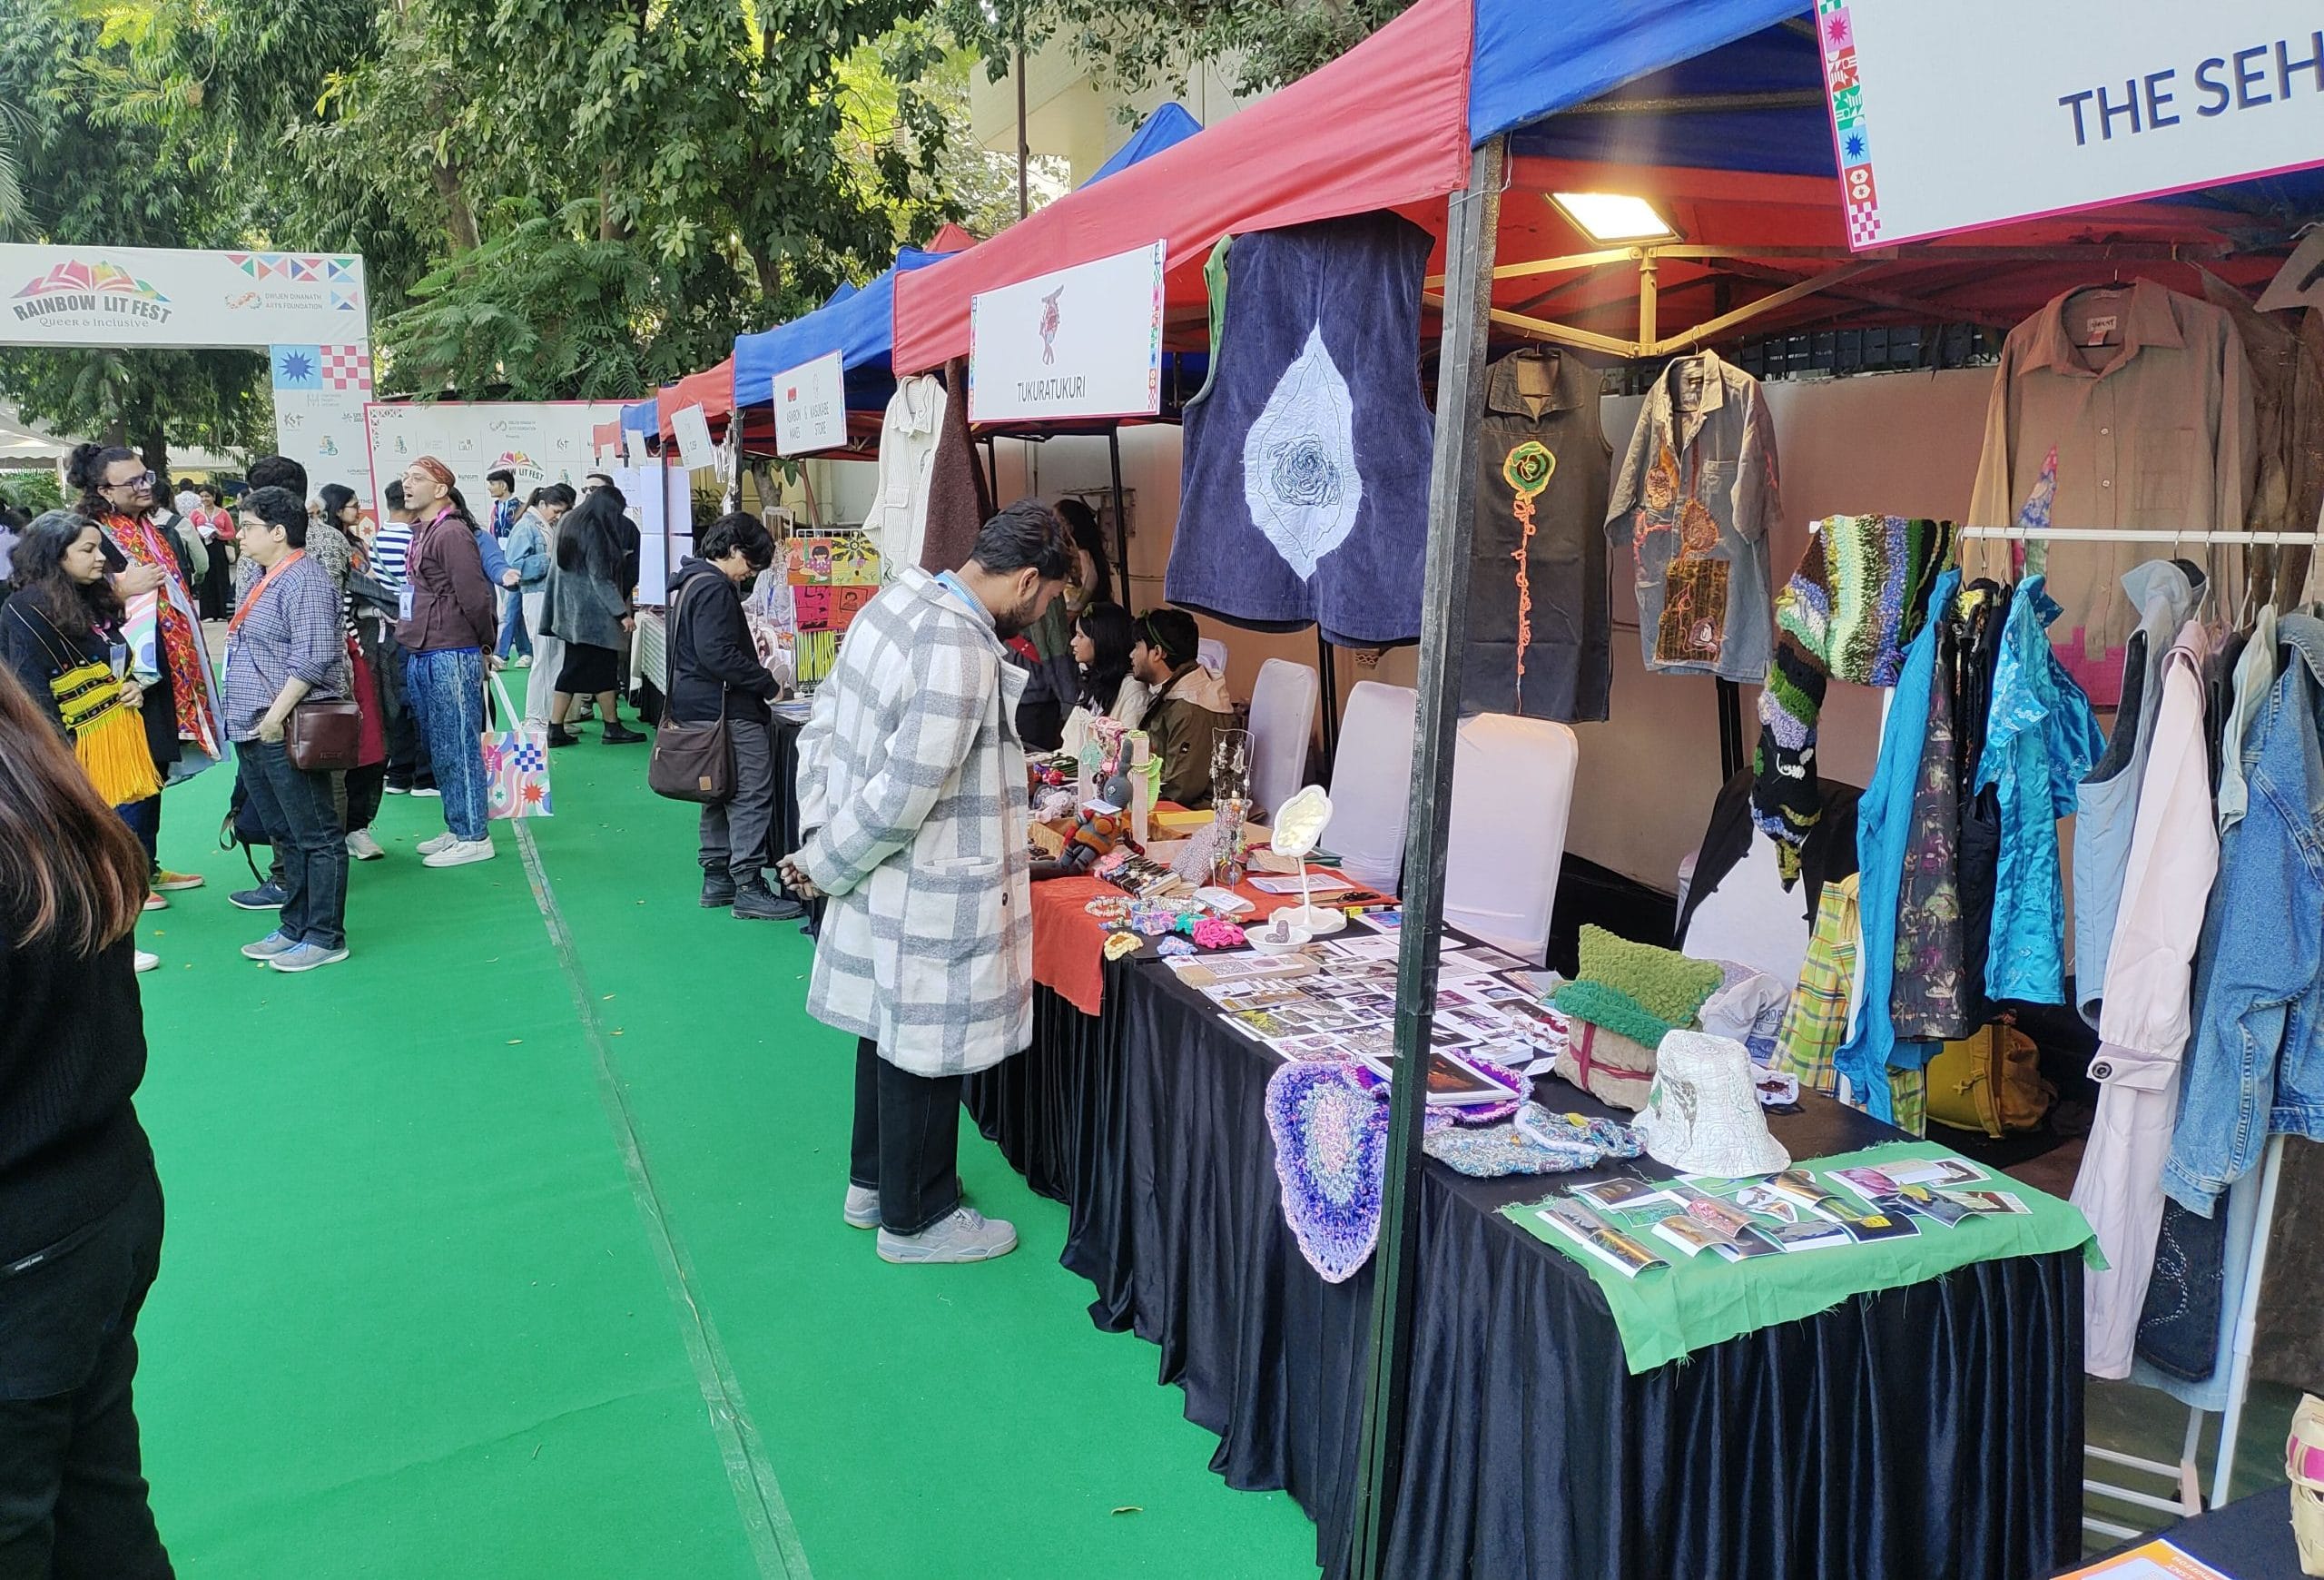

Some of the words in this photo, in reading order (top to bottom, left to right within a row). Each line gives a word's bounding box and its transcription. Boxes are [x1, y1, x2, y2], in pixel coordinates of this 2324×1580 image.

[2057, 68, 2181, 146] THE
[2194, 30, 2324, 117] SEH
[13, 295, 95, 321] RAINBOW
[104, 295, 129, 313] LIT
[132, 300, 172, 324] FEST
[1017, 375, 1086, 403] TUKURATUKURI
[518, 468, 528, 477] LIT
[528, 469, 545, 482] FEST
